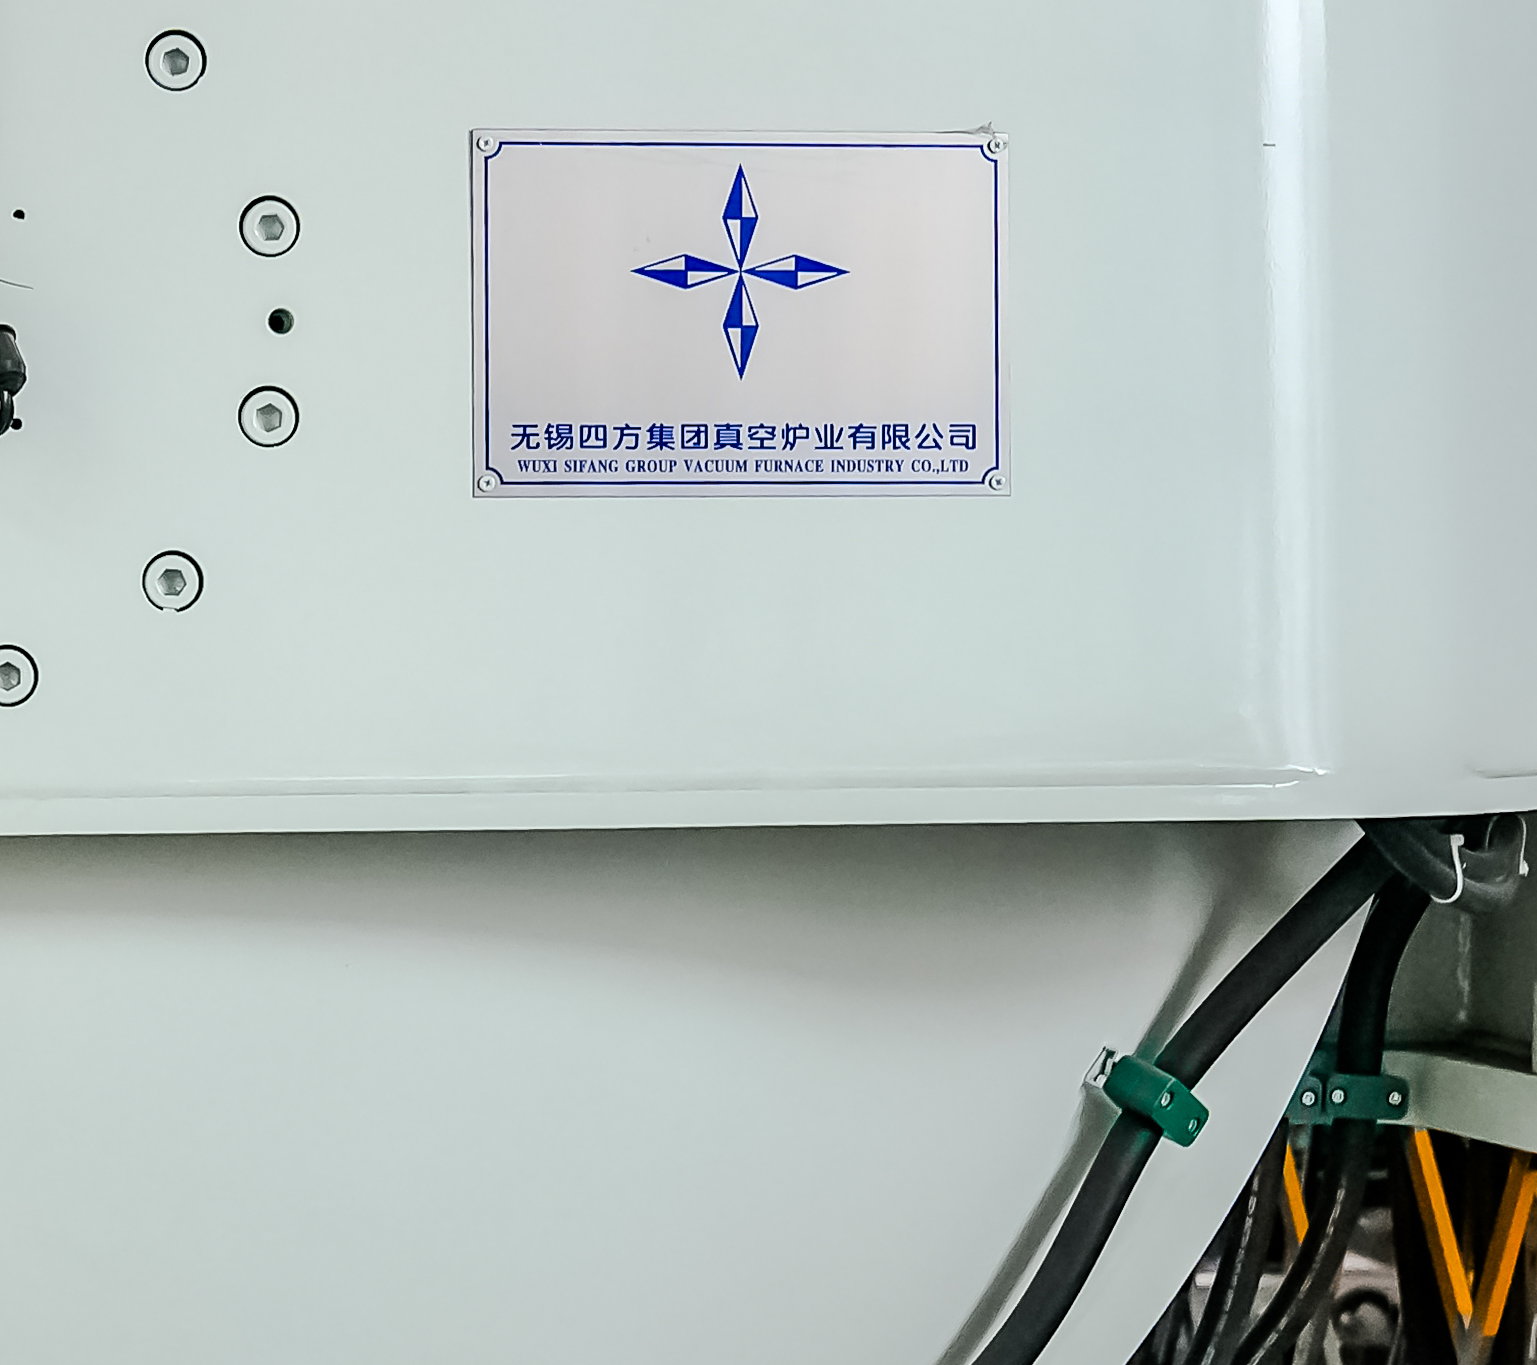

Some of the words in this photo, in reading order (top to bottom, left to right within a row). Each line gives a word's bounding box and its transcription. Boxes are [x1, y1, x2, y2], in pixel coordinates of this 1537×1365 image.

[510, 422, 977, 451] 无锡四方集团真空炉业有限公司
[517, 459, 558, 473] WUXI
[564, 459, 619, 473] SIFANG
[625, 459, 678, 473] GROUP
[684, 459, 748, 473] VACUUM
[754, 459, 824, 473] FURNACE
[830, 459, 905, 473] INDUSTRY
[911, 459, 969, 474] CO.,LTD
